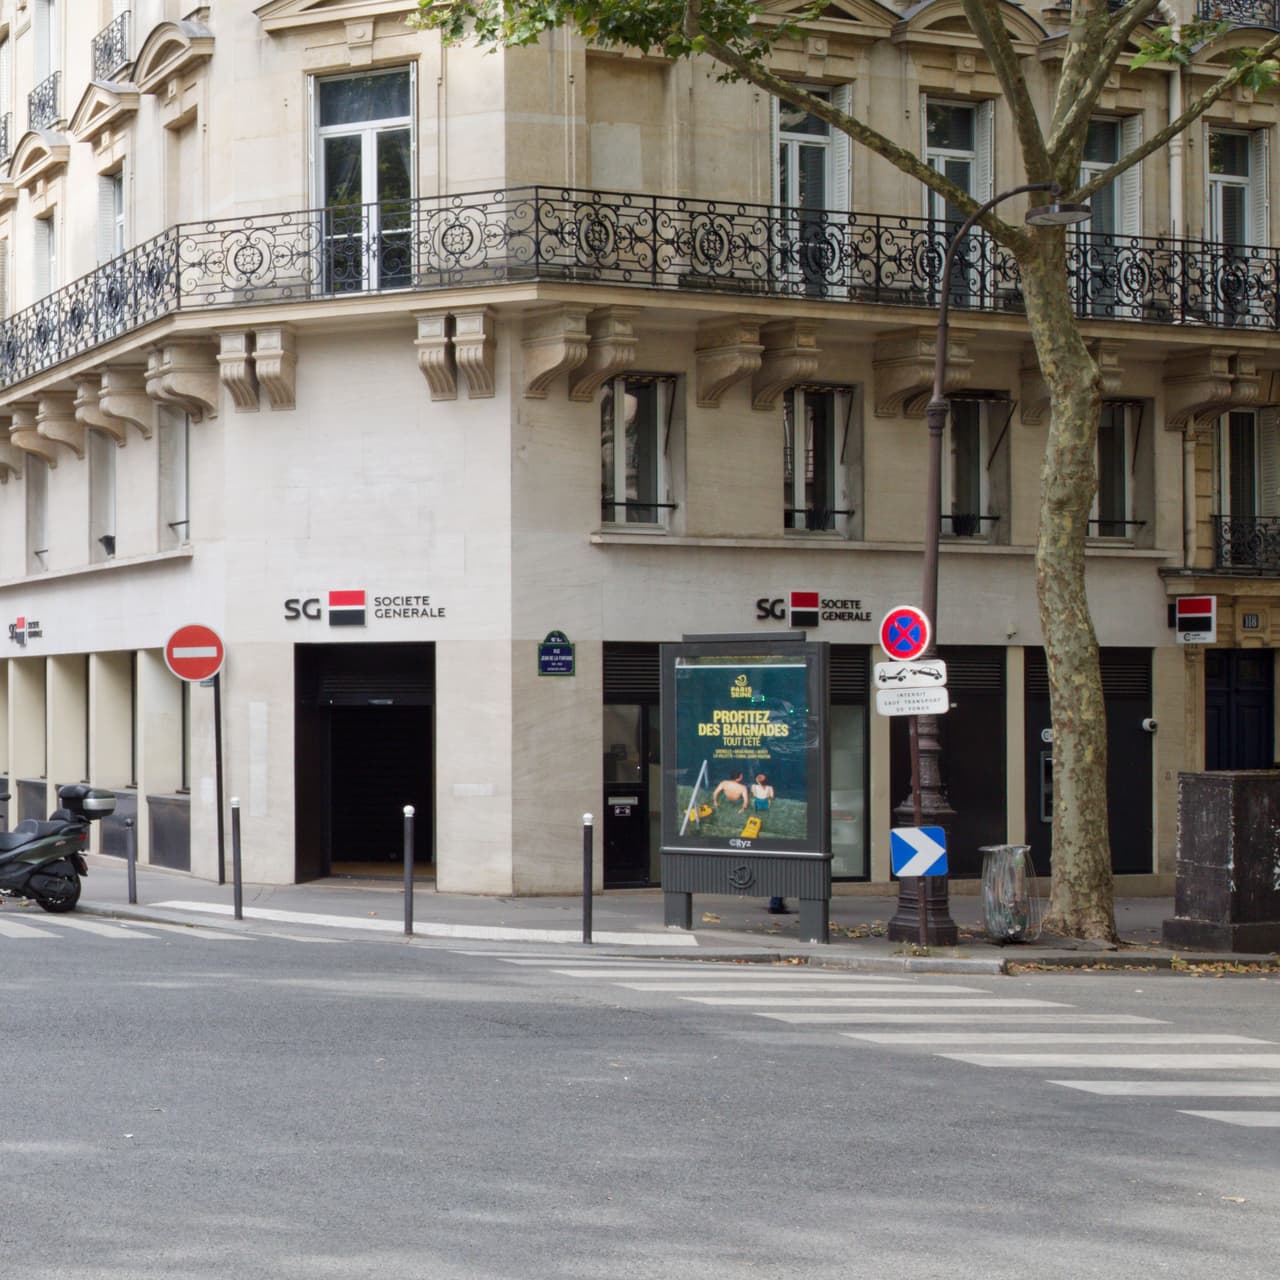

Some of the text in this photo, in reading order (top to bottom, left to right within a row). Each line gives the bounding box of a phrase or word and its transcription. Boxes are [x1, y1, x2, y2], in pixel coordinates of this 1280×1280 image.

[374, 596, 430, 607] SOCIETE
[821, 599, 861, 609] SOCIETE
[284, 598, 321, 620] SG
[374, 607, 445, 619] GENERALE
[756, 598, 785, 620] SG
[821, 611, 872, 621] GENERALE
[713, 710, 770, 723] PROFITEZ
[698, 723, 789, 737] DES BAIGNADES
[722, 737, 741, 746] TOUT
